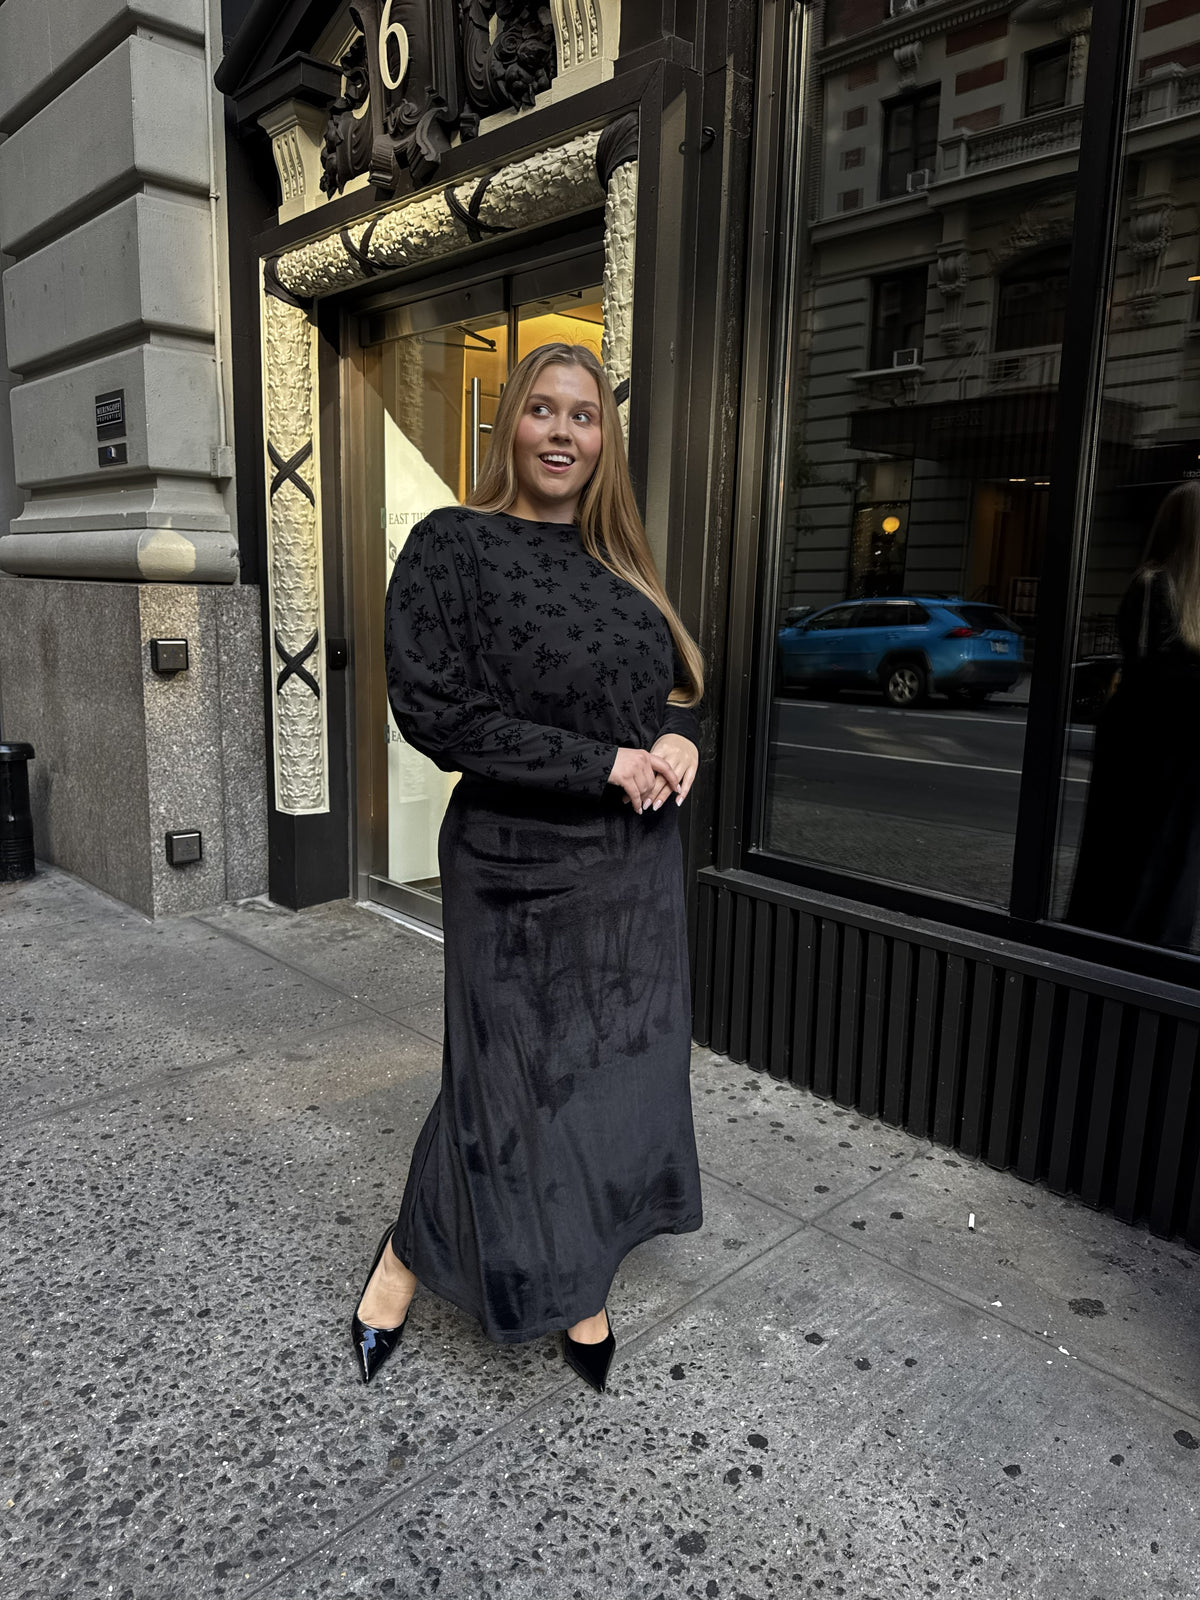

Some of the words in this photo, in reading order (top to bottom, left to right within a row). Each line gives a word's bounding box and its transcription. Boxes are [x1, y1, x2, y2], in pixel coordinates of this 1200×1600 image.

[378, 0, 409, 90] 6
[389, 513, 409, 525] EAST
[391, 730, 406, 743] EA
